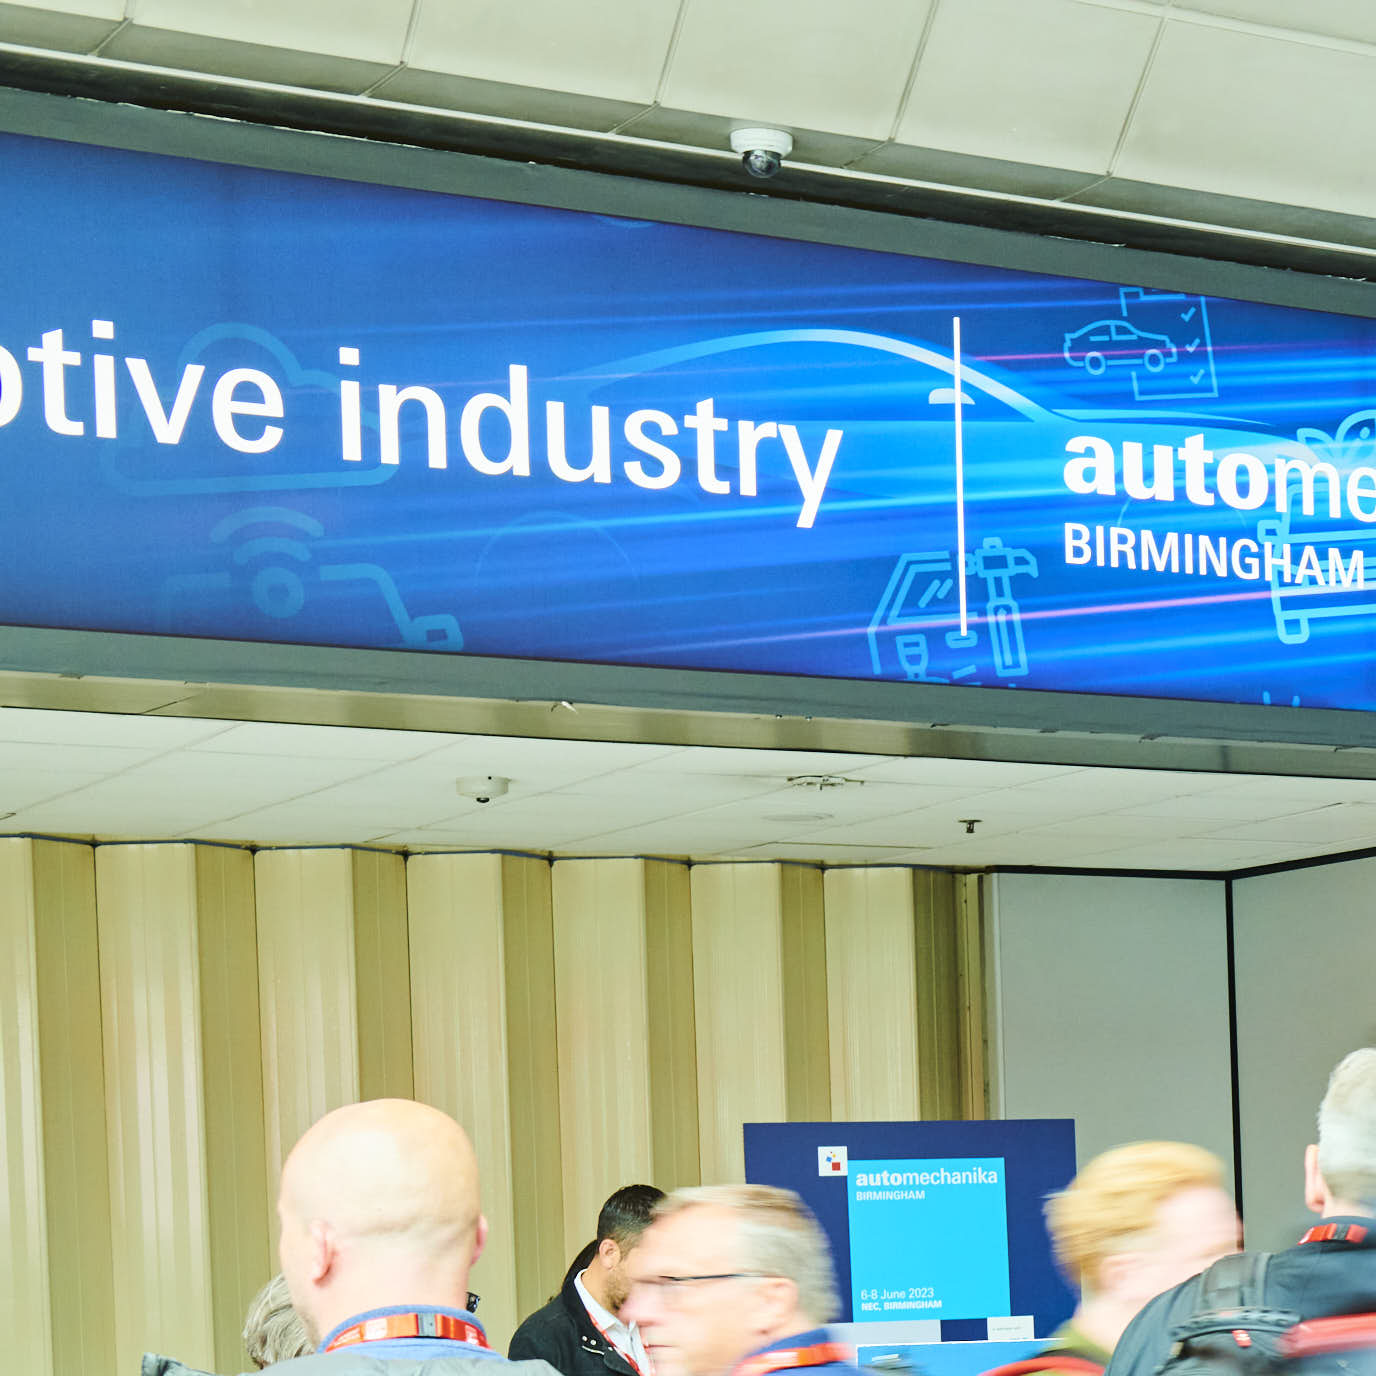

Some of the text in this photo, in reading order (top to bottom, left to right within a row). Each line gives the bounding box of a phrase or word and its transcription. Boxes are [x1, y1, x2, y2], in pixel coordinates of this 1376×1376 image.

[339, 347, 843, 528] industry
[1064, 522, 1365, 590] BIRMINGHAM
[856, 1167, 998, 1186] automechanika
[856, 1190, 925, 1201] BIRMINGHAM
[860, 1287, 935, 1300] 6-8 June 2023
[884, 1300, 942, 1311] BIRMINGHAM
